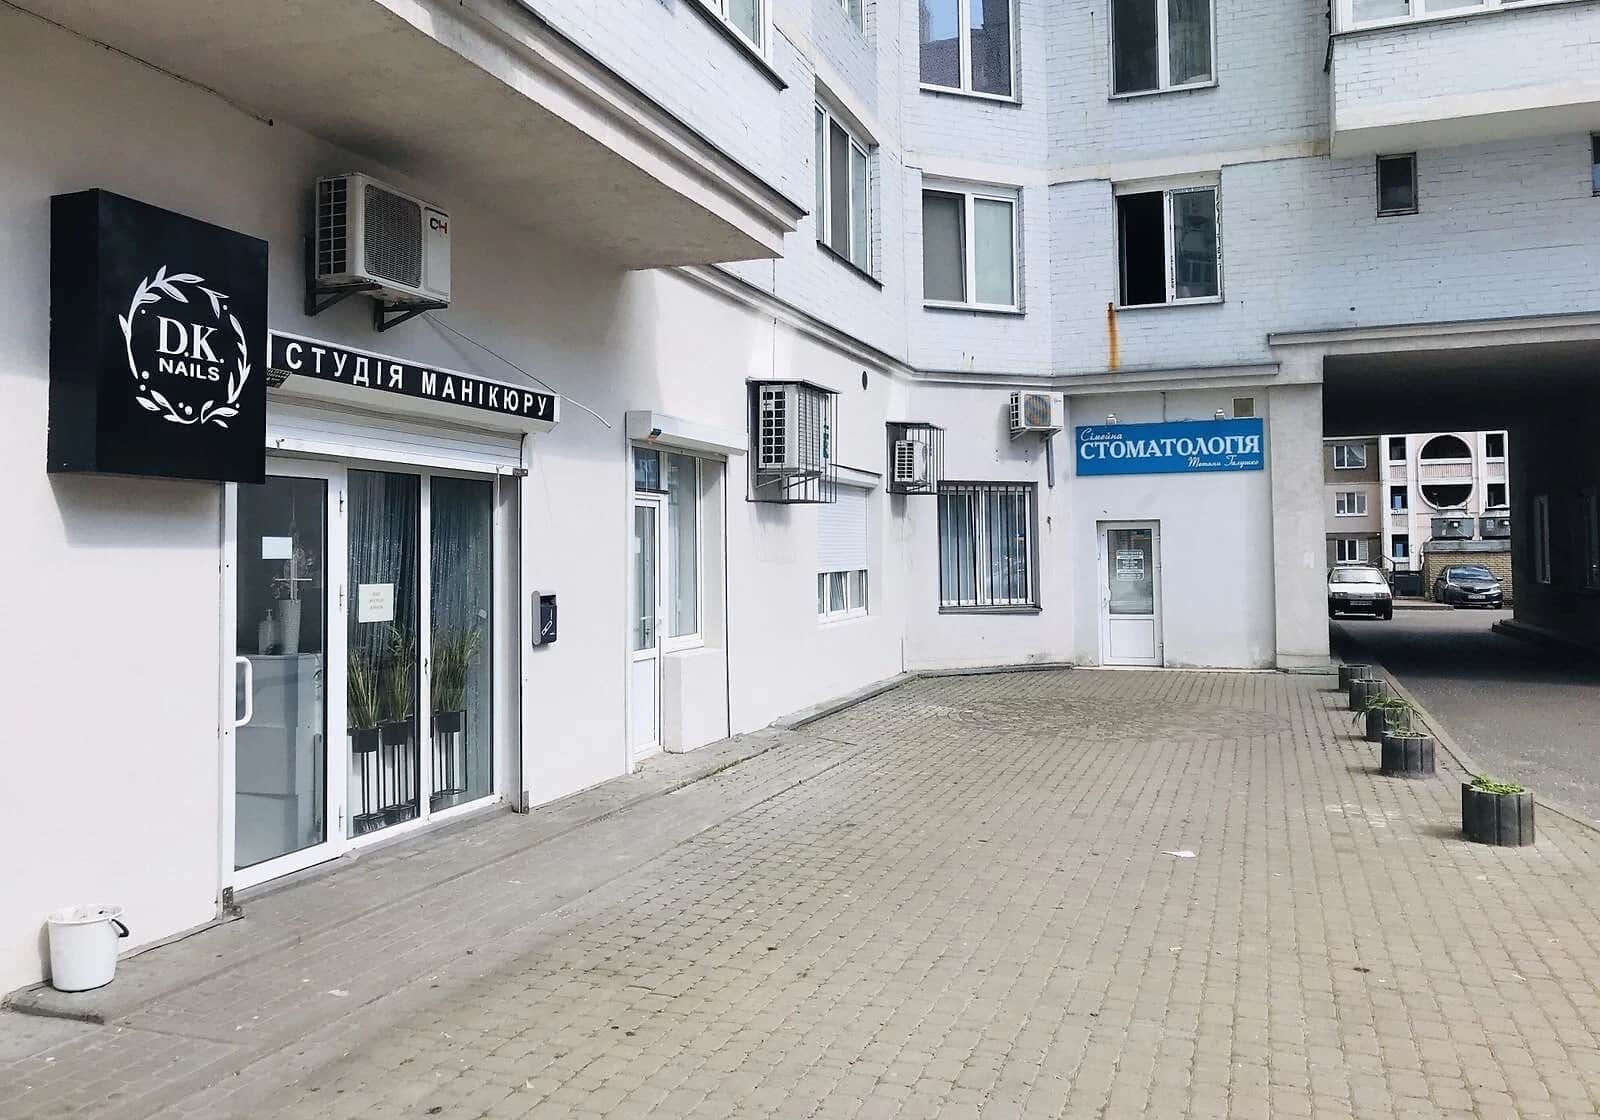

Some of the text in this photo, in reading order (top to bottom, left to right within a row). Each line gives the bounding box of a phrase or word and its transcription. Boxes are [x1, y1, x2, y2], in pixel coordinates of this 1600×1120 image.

[429, 217, 448, 234] CH
[159, 358, 220, 381] NAILS
[285, 342, 548, 416] СТУДІЯ МАНІКЮРУ
[1080, 428, 1123, 441] Сімейна
[1080, 435, 1260, 460] СТОМАТОЛОГІЯ
